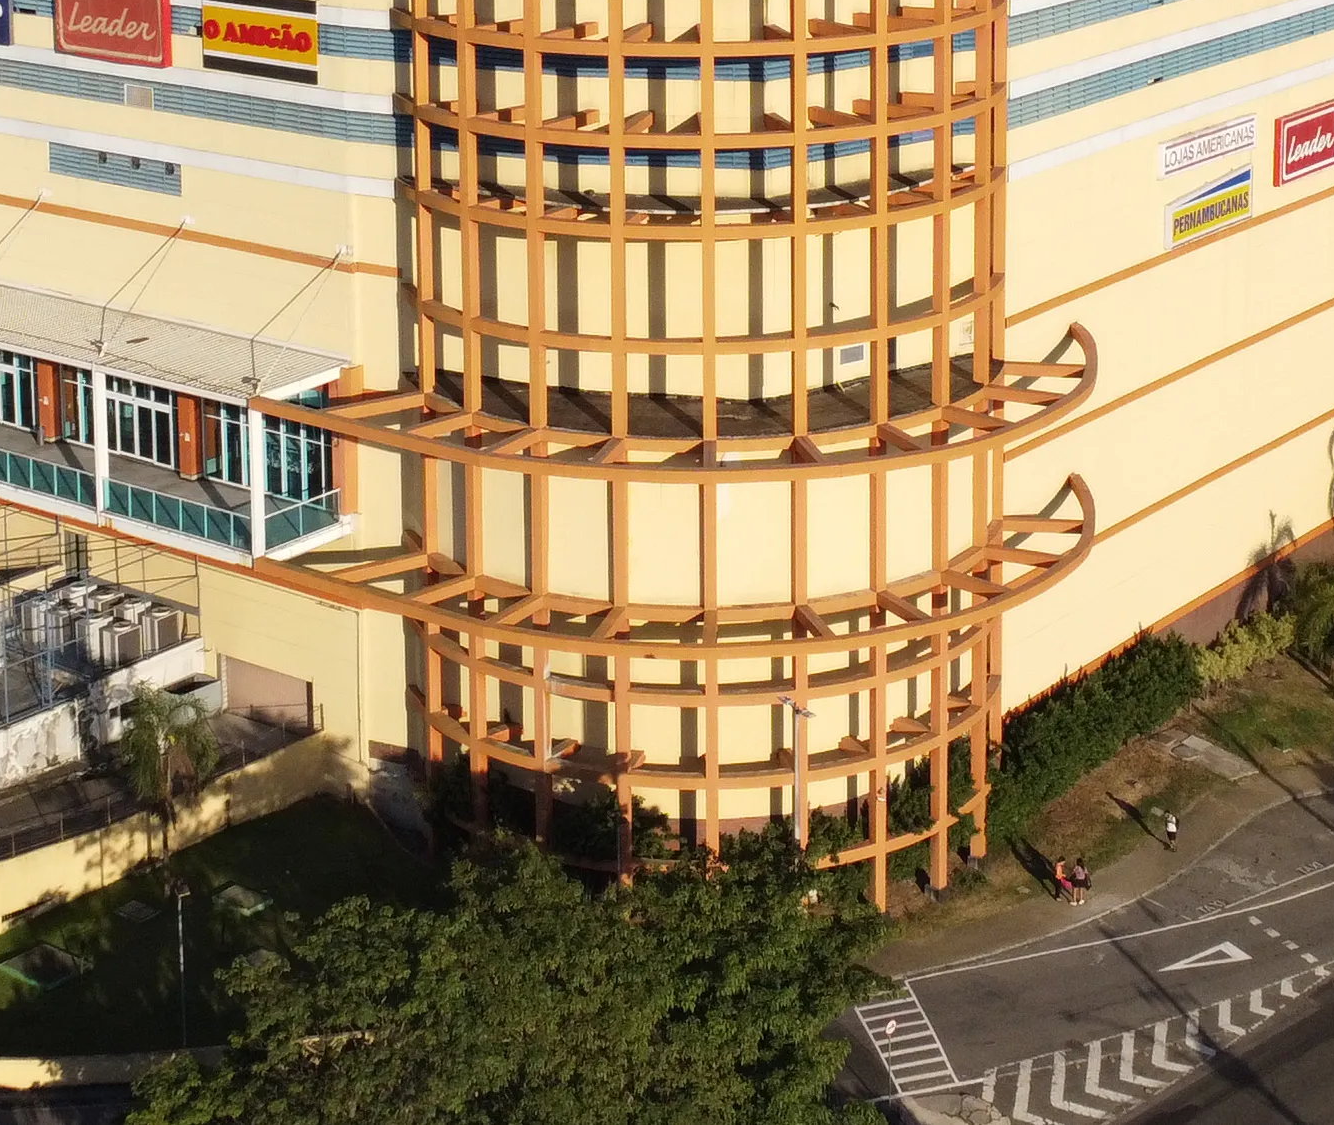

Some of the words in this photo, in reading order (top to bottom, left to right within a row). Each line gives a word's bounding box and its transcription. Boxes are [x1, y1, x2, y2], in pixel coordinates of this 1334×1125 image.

[68, 2, 157, 41] Leader
[203, 19, 221, 40] O
[223, 22, 313, 53] AMIGÃO
[1164, 145, 1195, 168] LOJAS
[1195, 125, 1255, 157] AMERICANAS
[1287, 126, 1334, 164] Leader
[1173, 191, 1249, 236] PERNAMBUCANAS
